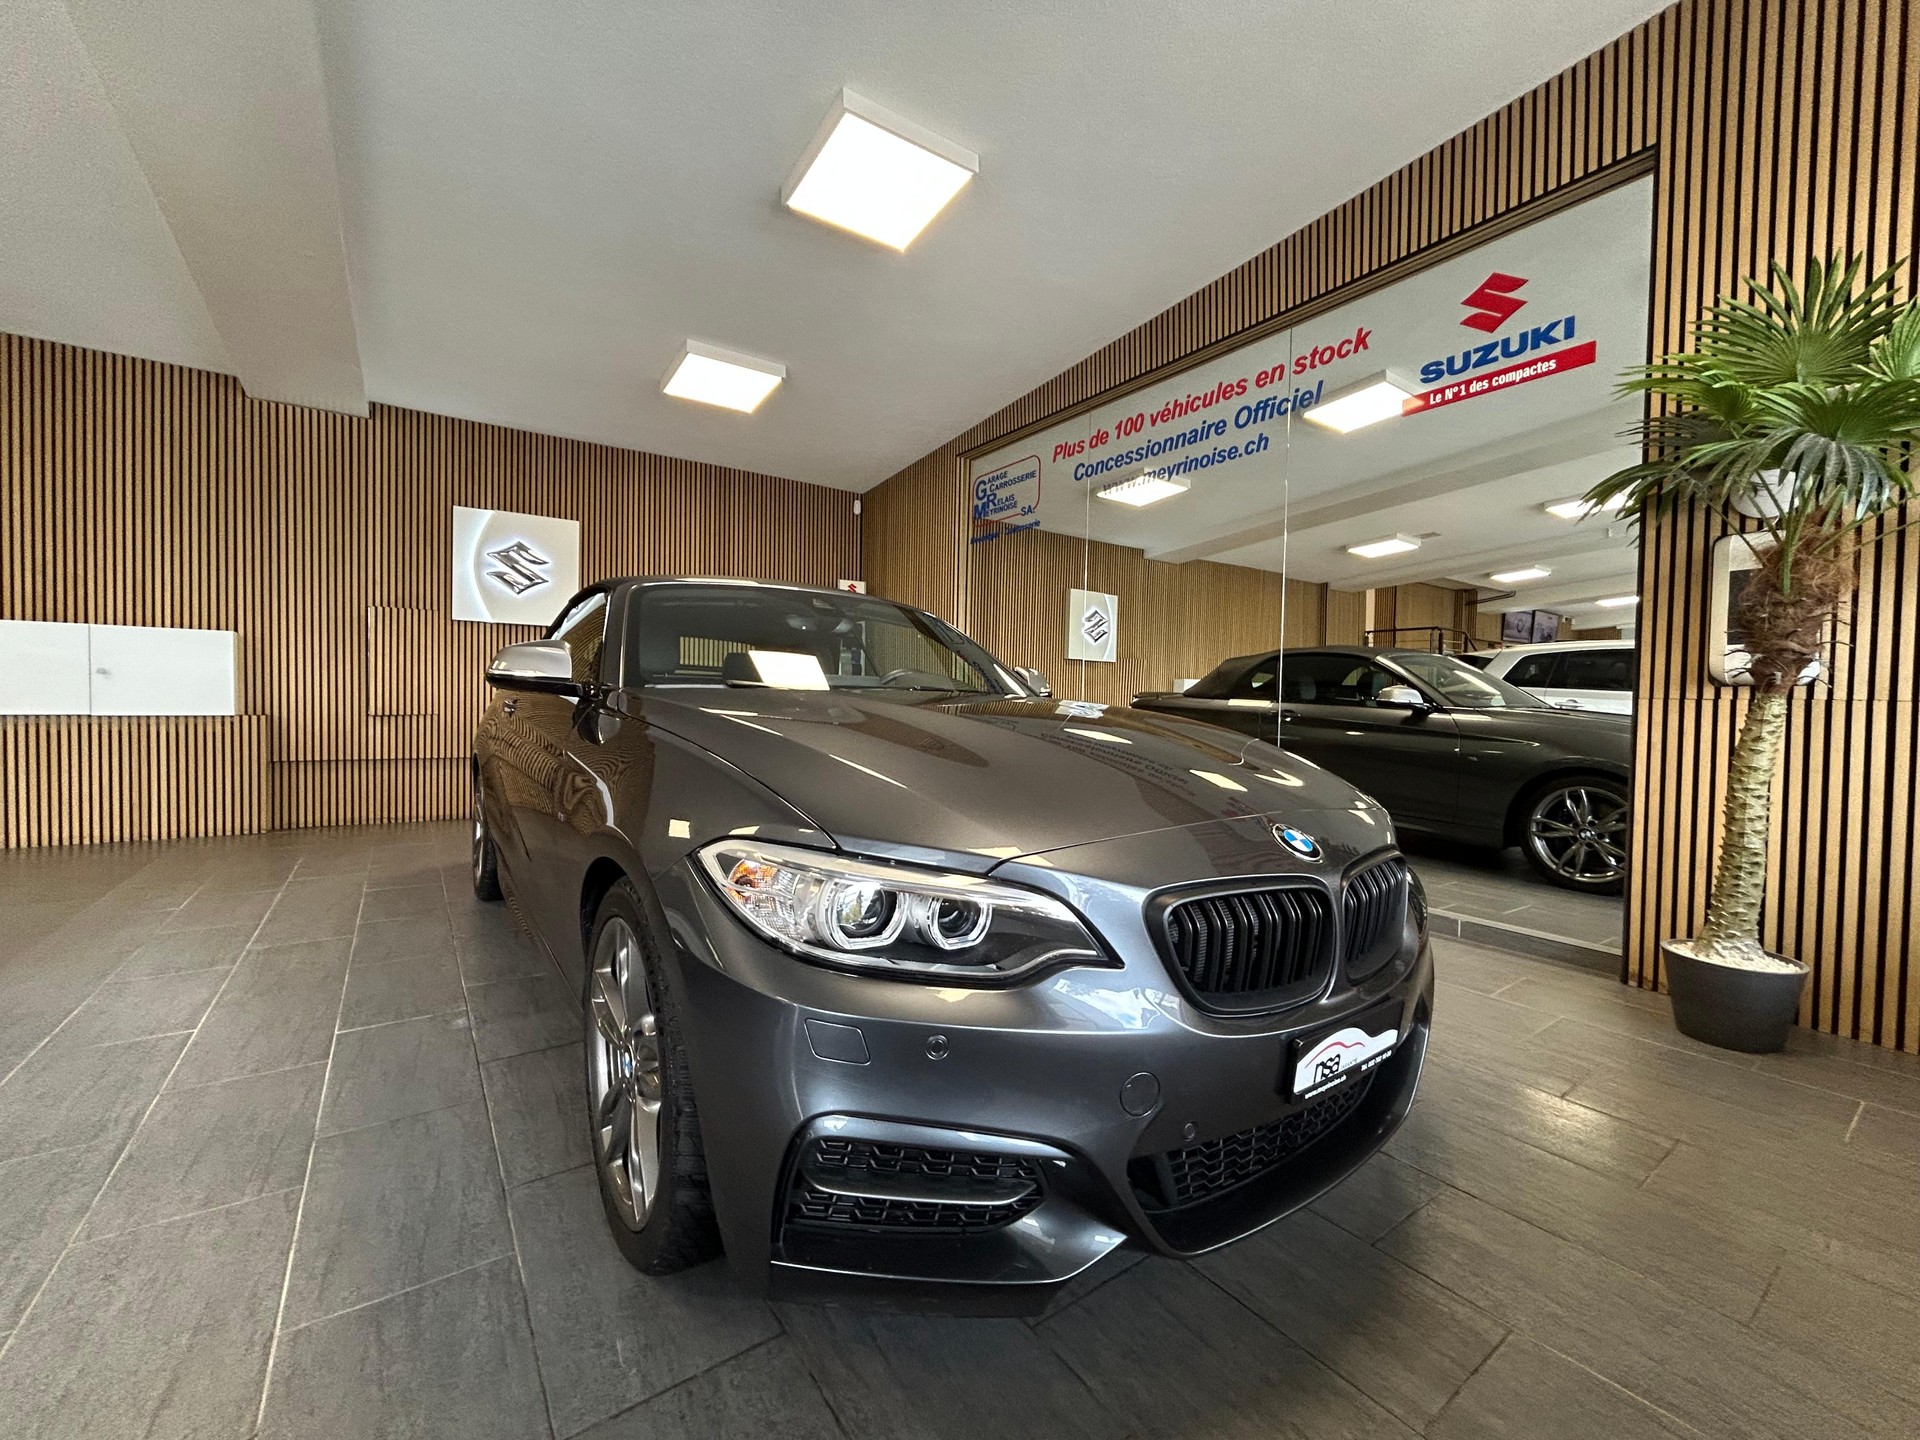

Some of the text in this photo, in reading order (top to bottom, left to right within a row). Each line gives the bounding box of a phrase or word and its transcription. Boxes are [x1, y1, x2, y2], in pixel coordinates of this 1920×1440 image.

[1419, 315, 1576, 384] SUZUKI
[1429, 392, 1442, 405] Le
[1469, 378, 1489, 393] des
[1492, 359, 1557, 387] compactes
[1052, 327, 1372, 463] Plus de 100 véhicules en stock
[1074, 379, 1324, 481] Concessionnaire Officiel
[989, 470, 1037, 493] CARROSSERIE
[1102, 433, 1269, 496] www.meyrinoise.ch
